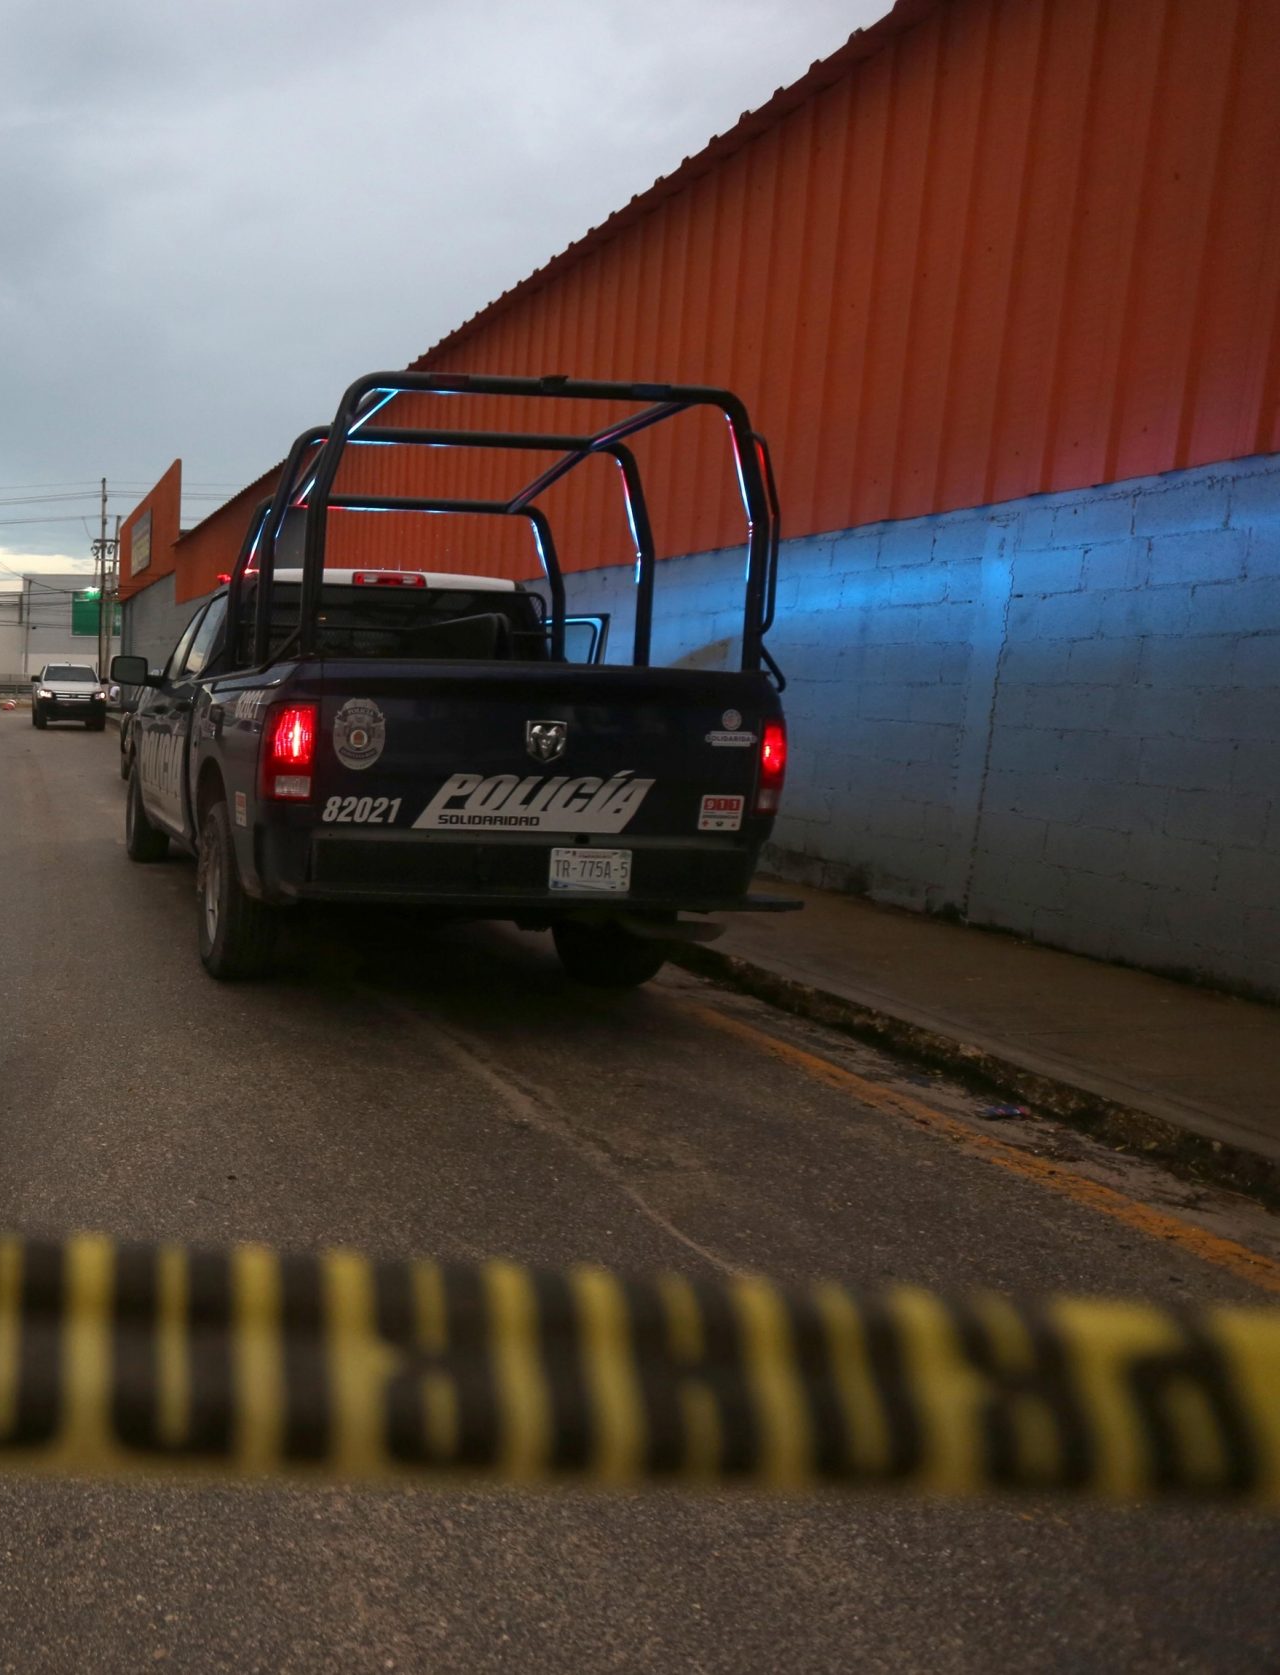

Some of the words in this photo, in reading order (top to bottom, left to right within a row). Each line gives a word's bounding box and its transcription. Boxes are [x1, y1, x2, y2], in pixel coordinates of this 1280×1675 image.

[428, 769, 656, 815] POLICÍA
[321, 795, 403, 823] 82021
[706, 799, 739, 810] 911
[438, 813, 540, 827] SOLIDARIDAD
[554, 859, 629, 879] TR-775A-5
